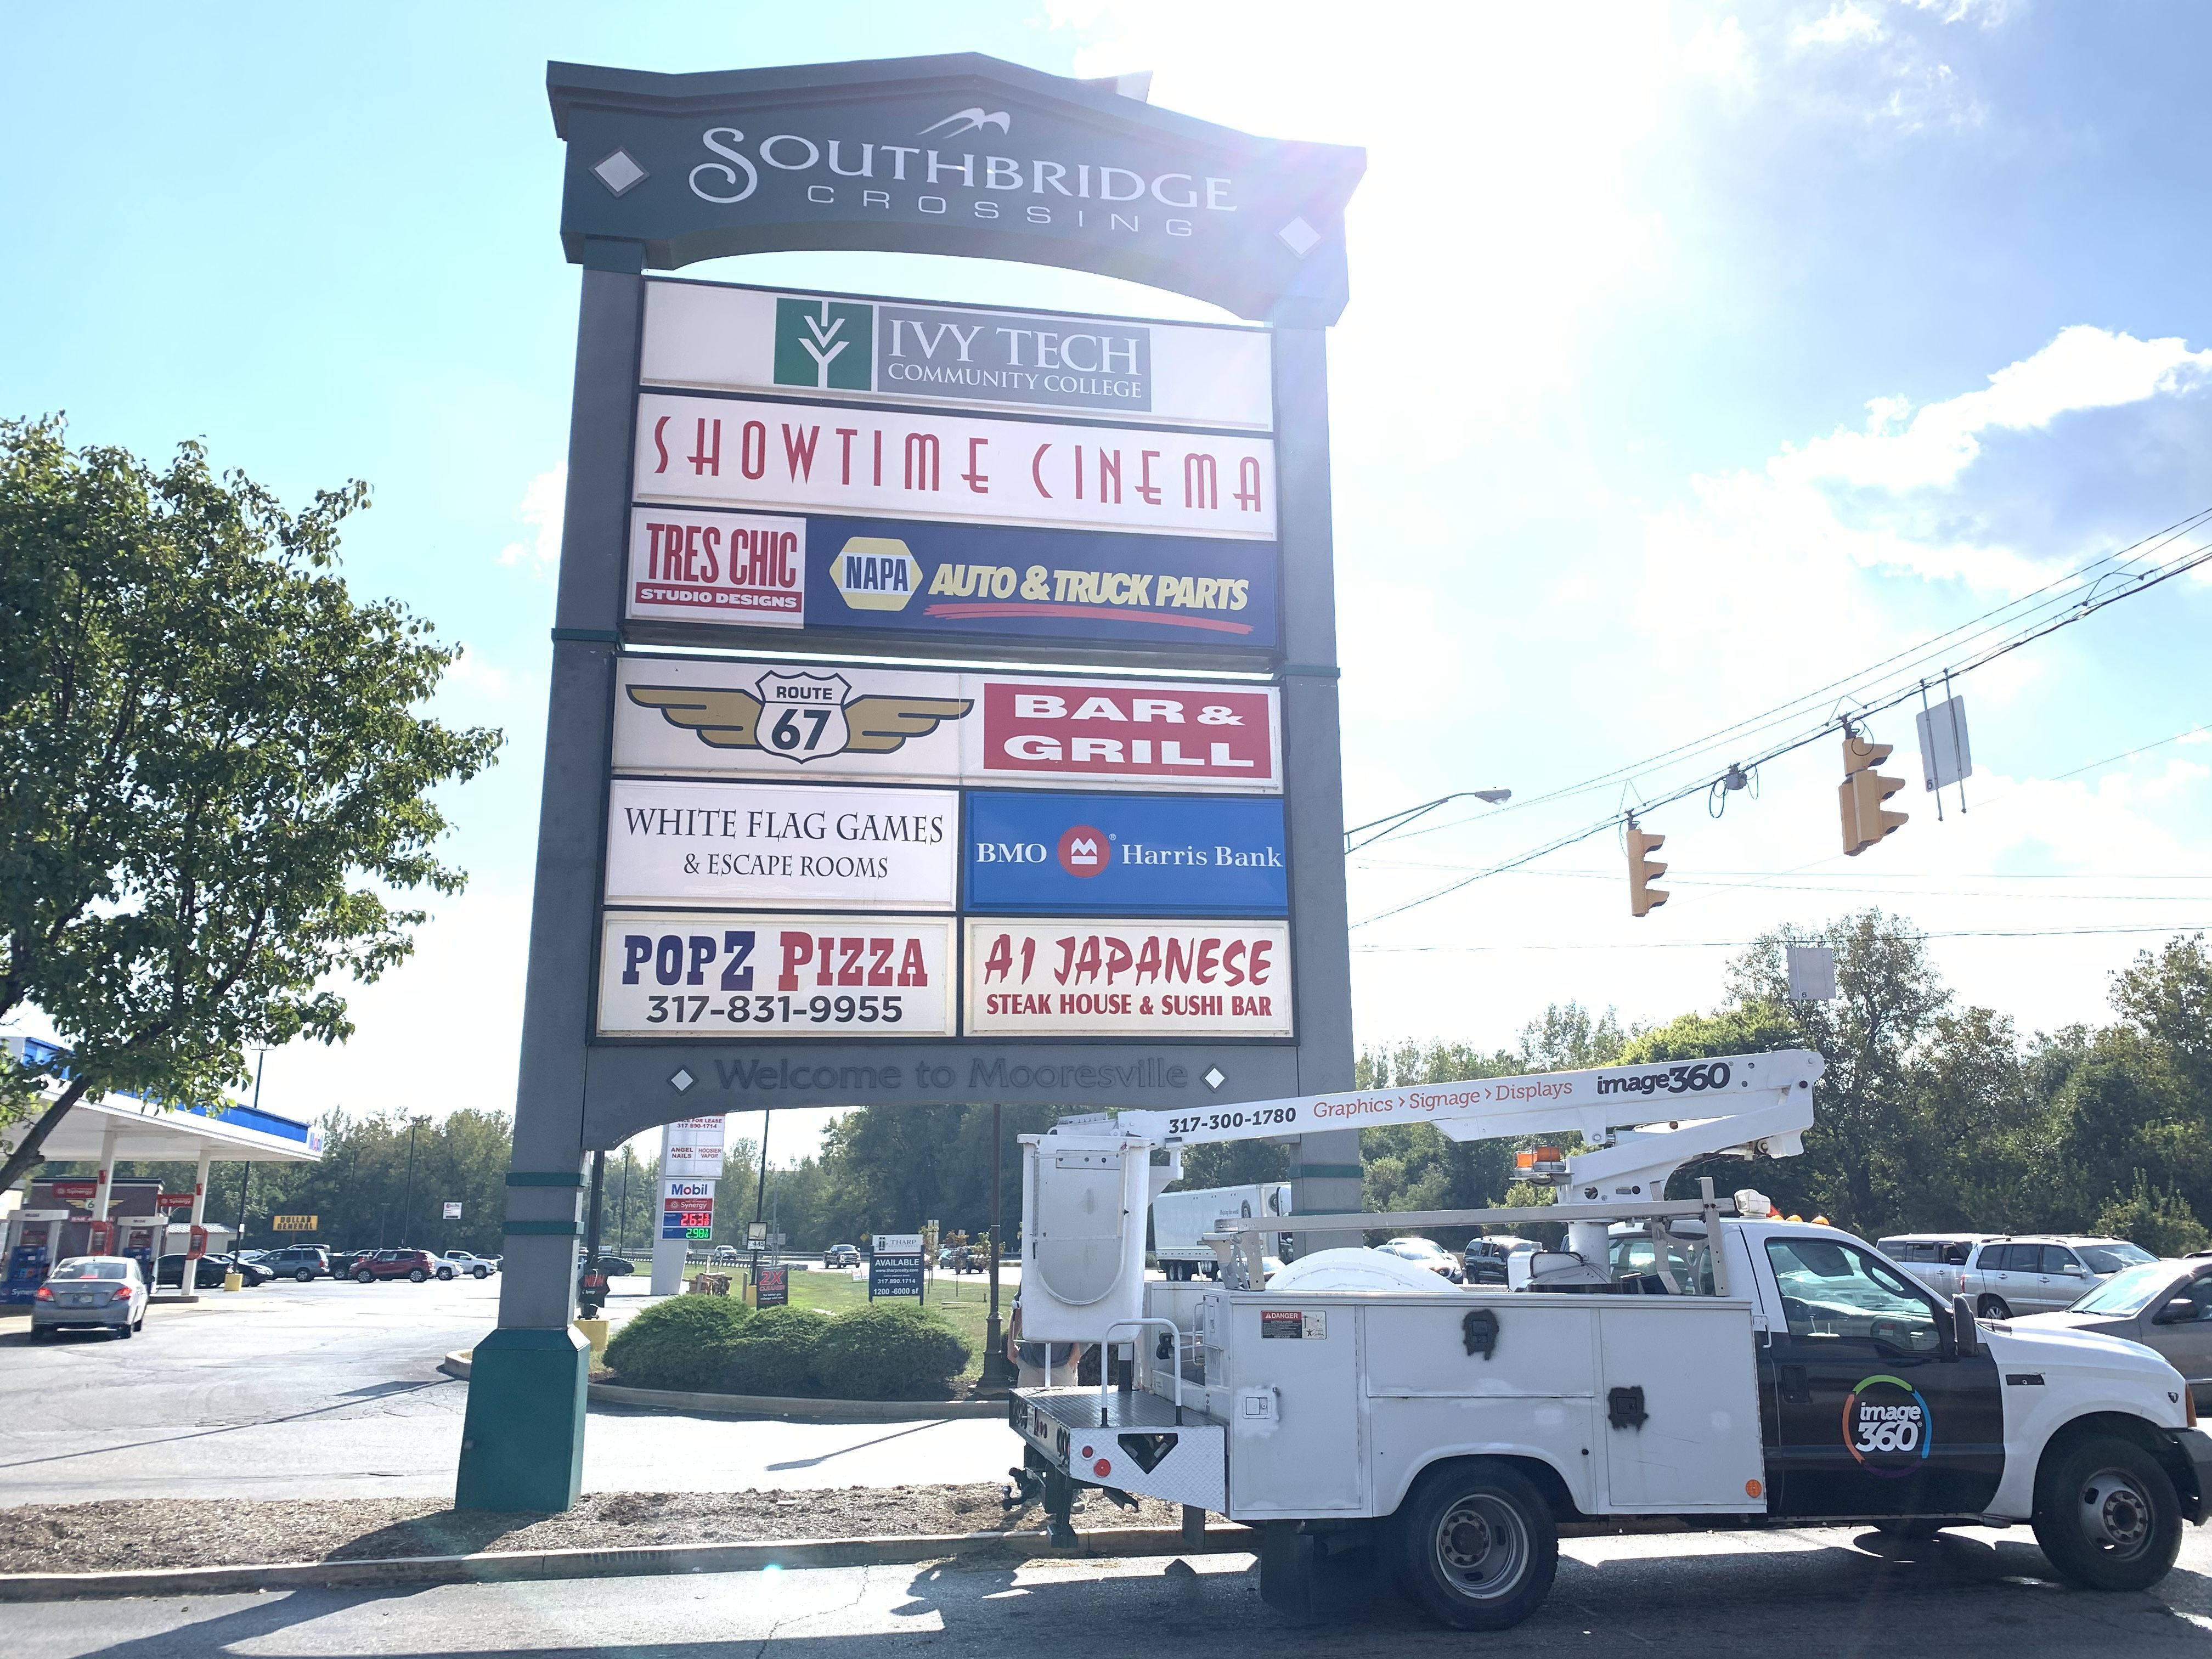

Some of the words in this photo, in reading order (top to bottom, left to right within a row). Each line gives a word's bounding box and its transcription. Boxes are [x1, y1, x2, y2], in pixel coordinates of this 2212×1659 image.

[688, 127, 1238, 211] SOUTHBRIDGE
[807, 185, 1192, 236] CROSSING
[888, 319, 985, 363] IVY
[996, 327, 1142, 376] TECH
[888, 362, 1040, 390] COMMUNITY
[1043, 374, 1142, 398] COLLEGE
[653, 415, 990, 495] SHOWTIME
[1032, 443, 1262, 513] CINEMA
[645, 522, 721, 584] TRES
[729, 528, 797, 588] CHIC
[845, 555, 909, 592] NAPA
[928, 563, 1018, 599] AUTO
[1019, 565, 1051, 601] &
[1052, 569, 1153, 606] TRUCK
[1154, 575, 1250, 611] PARTS
[640, 588, 712, 603] STUDIO
[715, 592, 797, 608] DESIGNS
[776, 686, 833, 700] ROUTE
[1014, 694, 1186, 724] BAR
[1196, 706, 1246, 726] &
[771, 708, 832, 751] 67
[1003, 735, 1255, 768] GRILL
[623, 807, 737, 840] WHITE
[746, 809, 827, 842] FLAG
[836, 811, 944, 846] GAMES
[683, 853, 701, 876] &
[707, 853, 793, 878] ESCAPE
[799, 855, 889, 880] ROOMS
[976, 842, 1047, 864] BMO
[1121, 844, 1208, 866] Harris
[1214, 846, 1284, 868] Bank
[621, 930, 756, 991] POPZ
[777, 930, 928, 991] PIZZA
[984, 933, 1036, 985] A1
[1053, 935, 1273, 987] JAPANESE
[645, 995, 903, 1023] 317-831-9955
[986, 993, 1053, 1015] STEAK
[1059, 994, 1132, 1015] HOUSE
[1138, 996, 1154, 1015] &
[1161, 995, 1223, 1017] SUSHI
[1232, 996, 1273, 1017] BAR
[714, 1058, 901, 1090] Welcome
[916, 1060, 956, 1090] to
[968, 1057, 1188, 1089] Mooresville
[1169, 1107, 1296, 1134] 317-300-1780
[1313, 1097, 1393, 1119] Graphics
[1409, 1091, 1480, 1111] Signage
[1495, 1081, 1573, 1101] Displays
[671, 1184, 708, 1195] Mobil
[680, 1201, 707, 1210] Synergy
[759, 1269, 785, 1286] 2X
[1860, 1402, 1921, 1422] image
